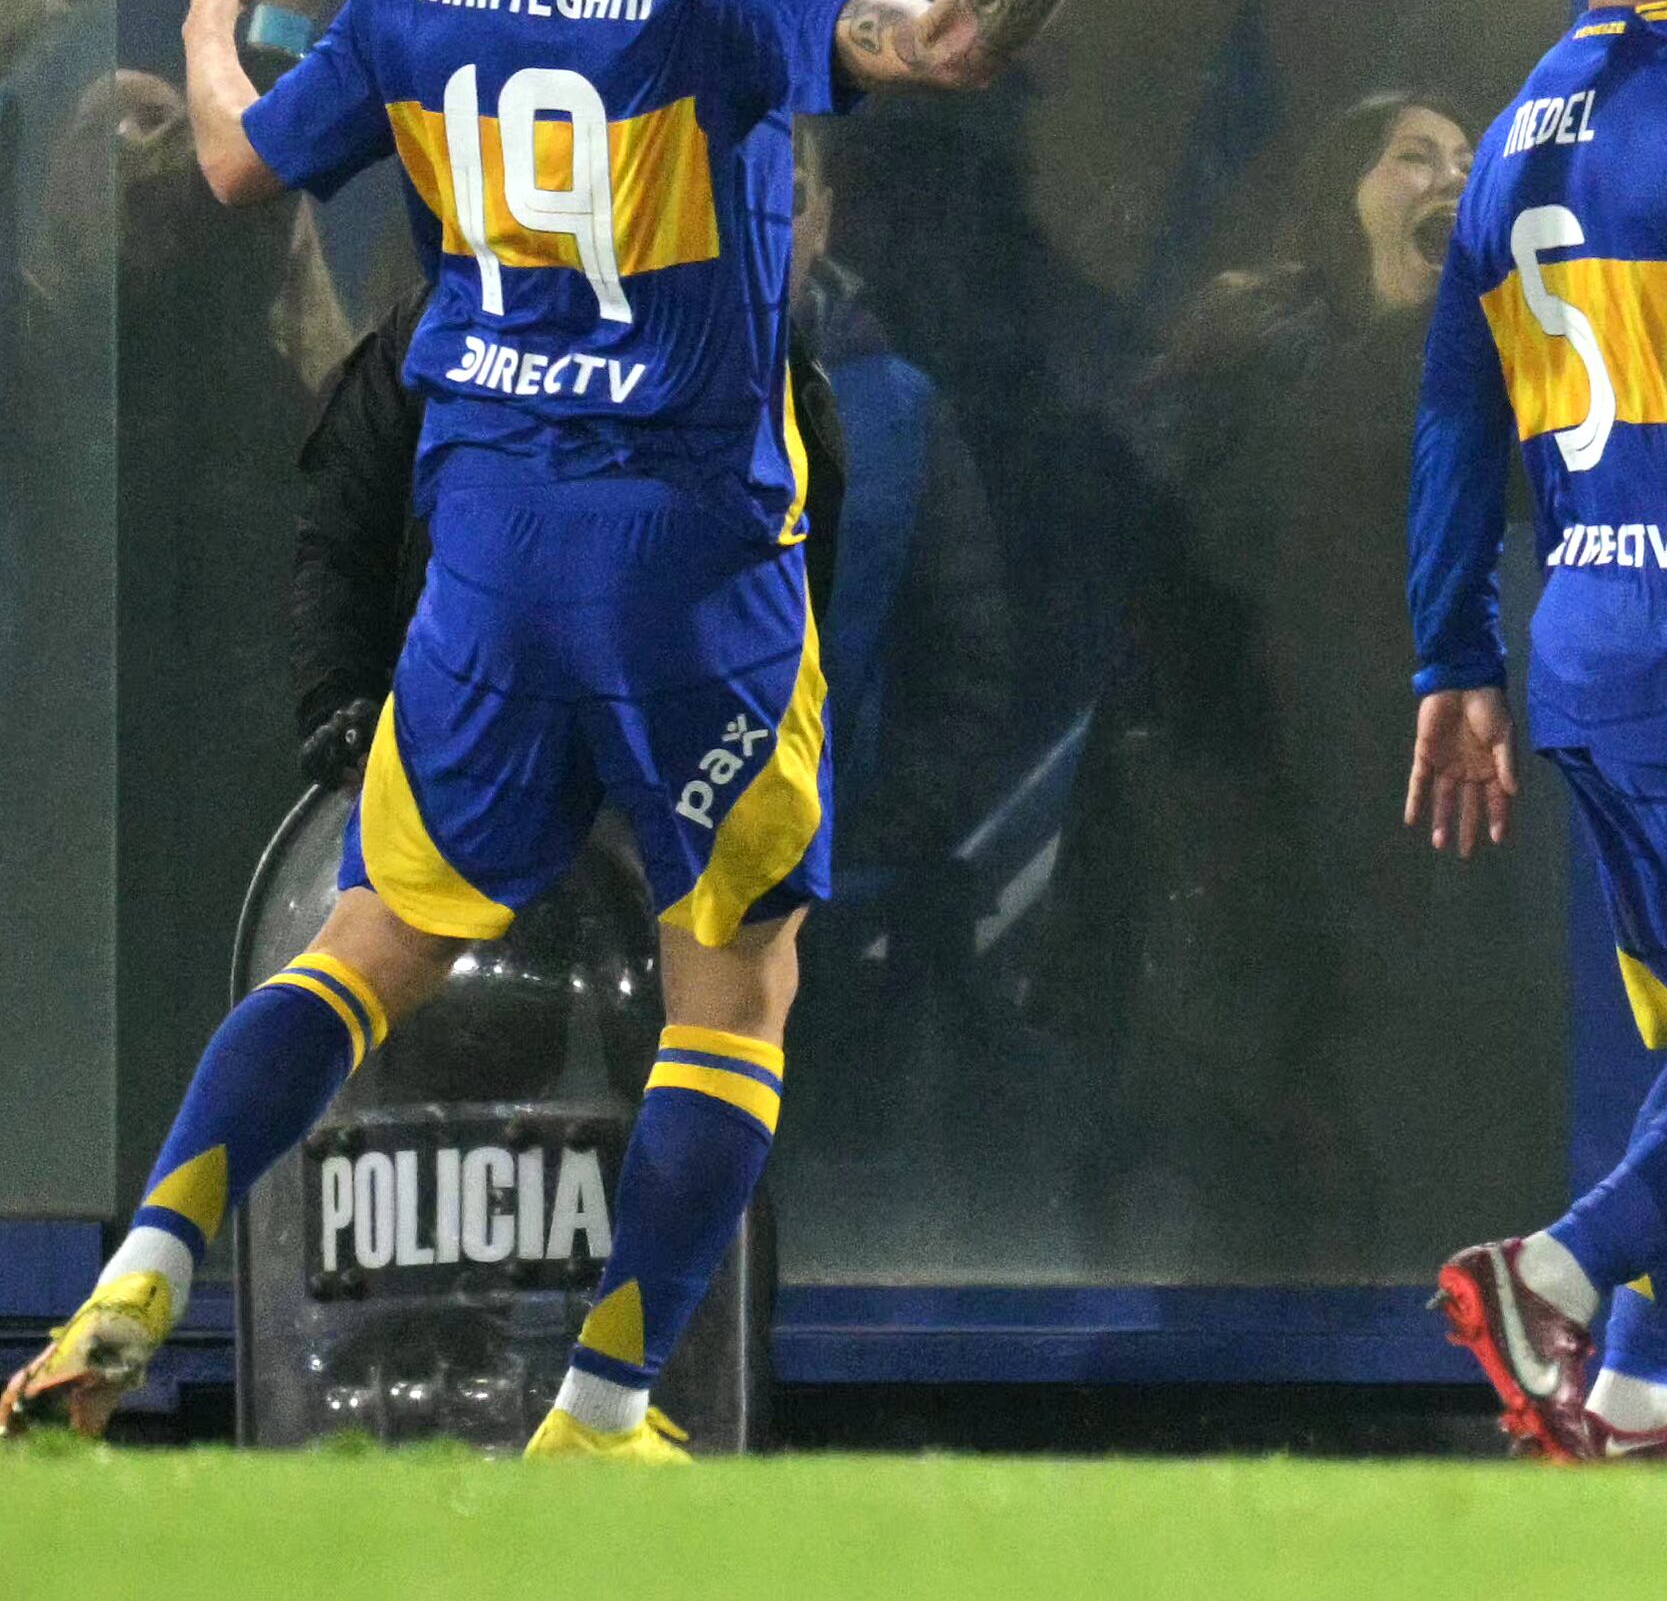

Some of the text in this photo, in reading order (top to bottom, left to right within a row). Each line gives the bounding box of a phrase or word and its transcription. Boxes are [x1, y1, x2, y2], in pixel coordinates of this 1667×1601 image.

[1503, 89, 1596, 159] MEDEL
[443, 63, 633, 324] 19
[446, 335, 646, 403] DIRECTV
[1511, 204, 1616, 472] 5
[676, 713, 768, 829] pax
[321, 1147, 613, 1271] POLICIA
